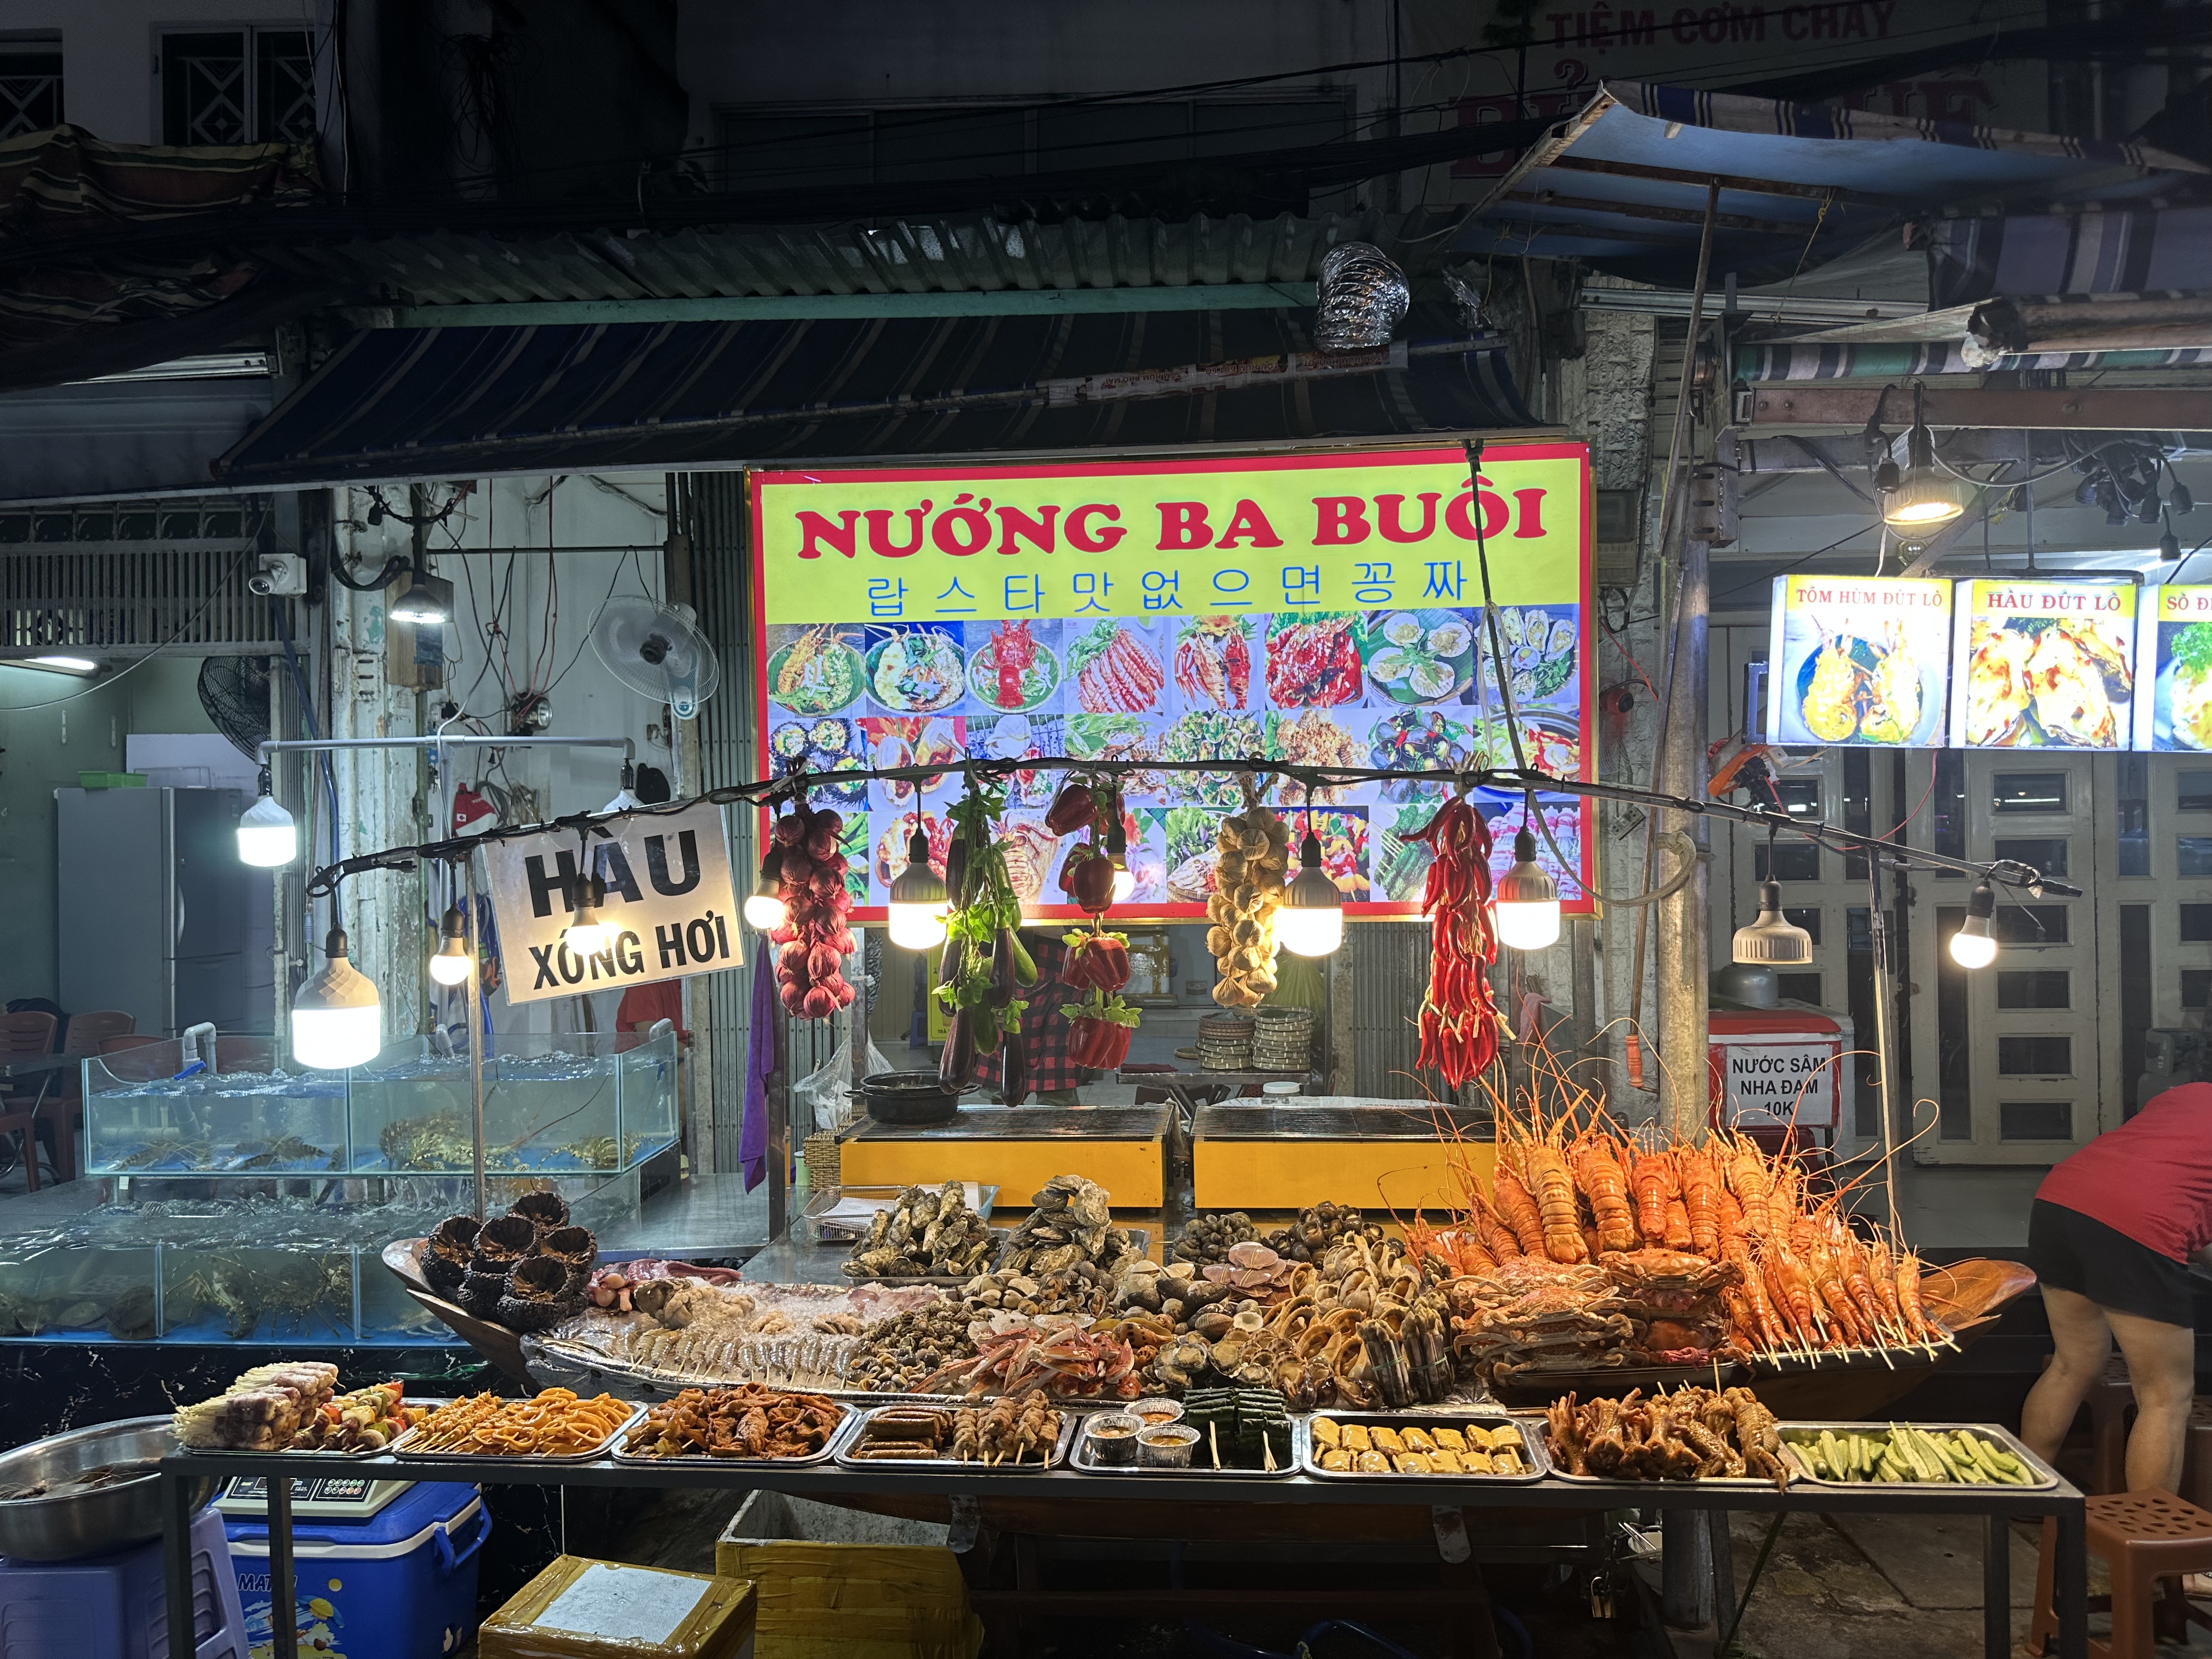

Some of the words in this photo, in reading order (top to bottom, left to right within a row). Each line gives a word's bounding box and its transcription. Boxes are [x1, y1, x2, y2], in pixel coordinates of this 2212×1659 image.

[1547, 2, 1655, 55] TIỆM
[1671, 1, 1767, 45] CƠM
[1781, 0, 1897, 41] CHAY
[795, 493, 1128, 560] NƯỚNG
[1155, 499, 1284, 551] BA
[1796, 585, 1833, 603] TÔM
[1838, 587, 1876, 605] HÙM
[1883, 589, 1916, 606] ĐÚT
[1922, 590, 1943, 607] LÒ
[1986, 588, 2034, 609] HÀU
[2041, 589, 2087, 610] ĐÚT
[2094, 590, 2121, 611] LÒ
[2166, 591, 2190, 611] SÒ
[524, 826, 701, 918] HÀU
[656, 910, 730, 969] HƠI
[1733, 1054, 1785, 1074] NƯỚC
[1790, 1053, 1826, 1073] SÂM
[1740, 1080, 1777, 1096] NHA
[1780, 1078, 1818, 1095] ĐAM
[1764, 1101, 1795, 1116] 10K
